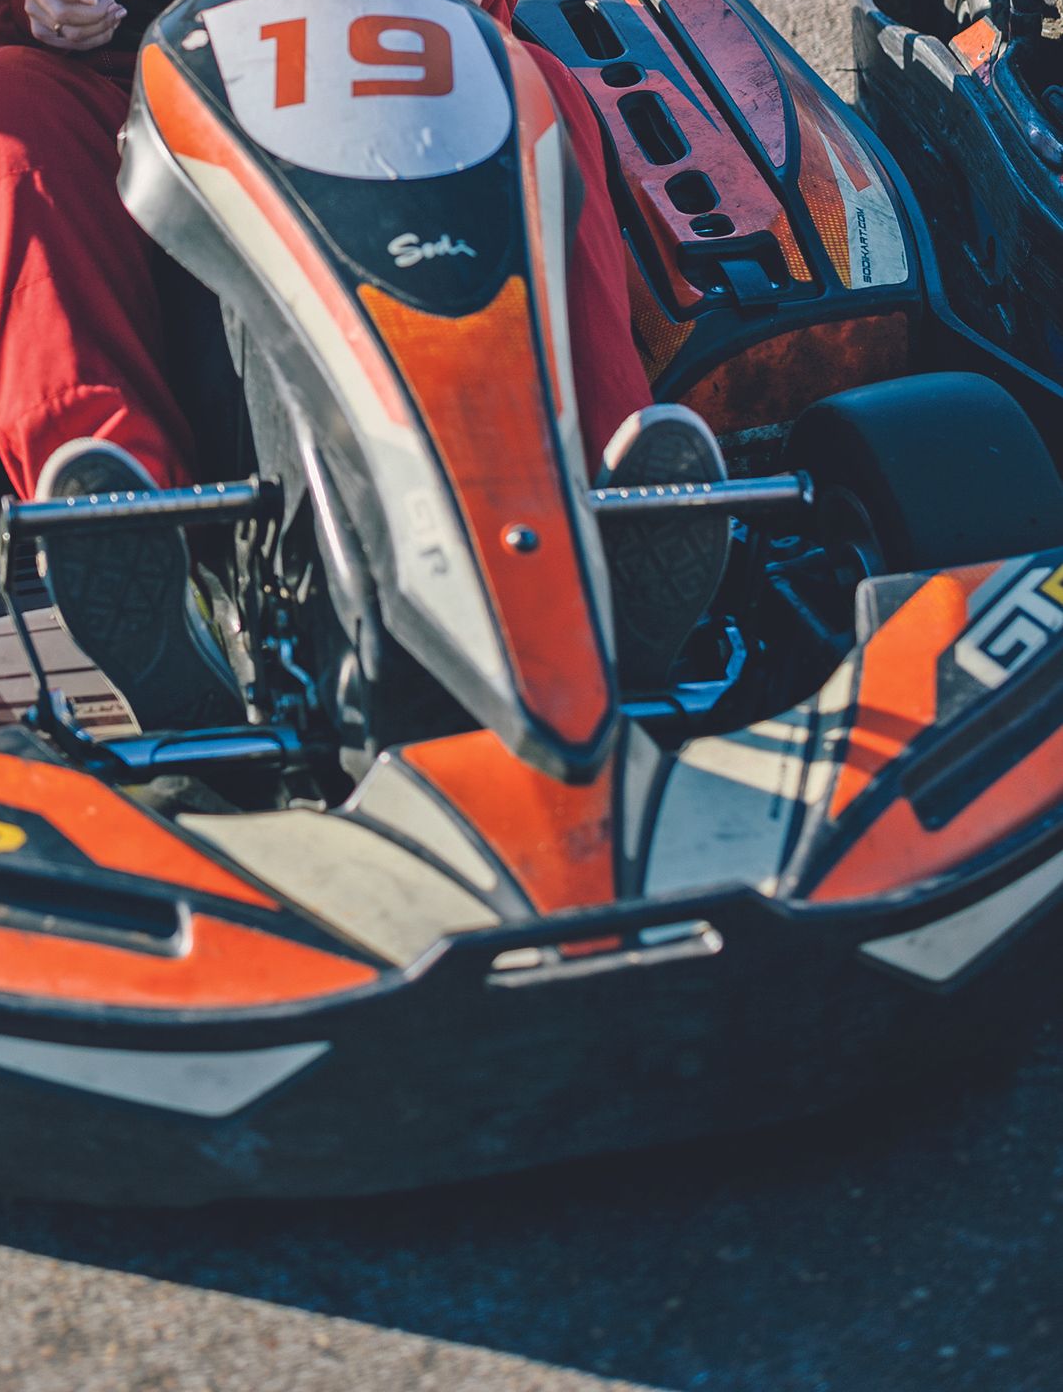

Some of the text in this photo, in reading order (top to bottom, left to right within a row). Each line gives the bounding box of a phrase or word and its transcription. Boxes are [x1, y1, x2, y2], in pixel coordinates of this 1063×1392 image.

[260, 15, 454, 109] 19
[387, 233, 477, 267] Sodi
[954, 562, 1063, 690] GT
